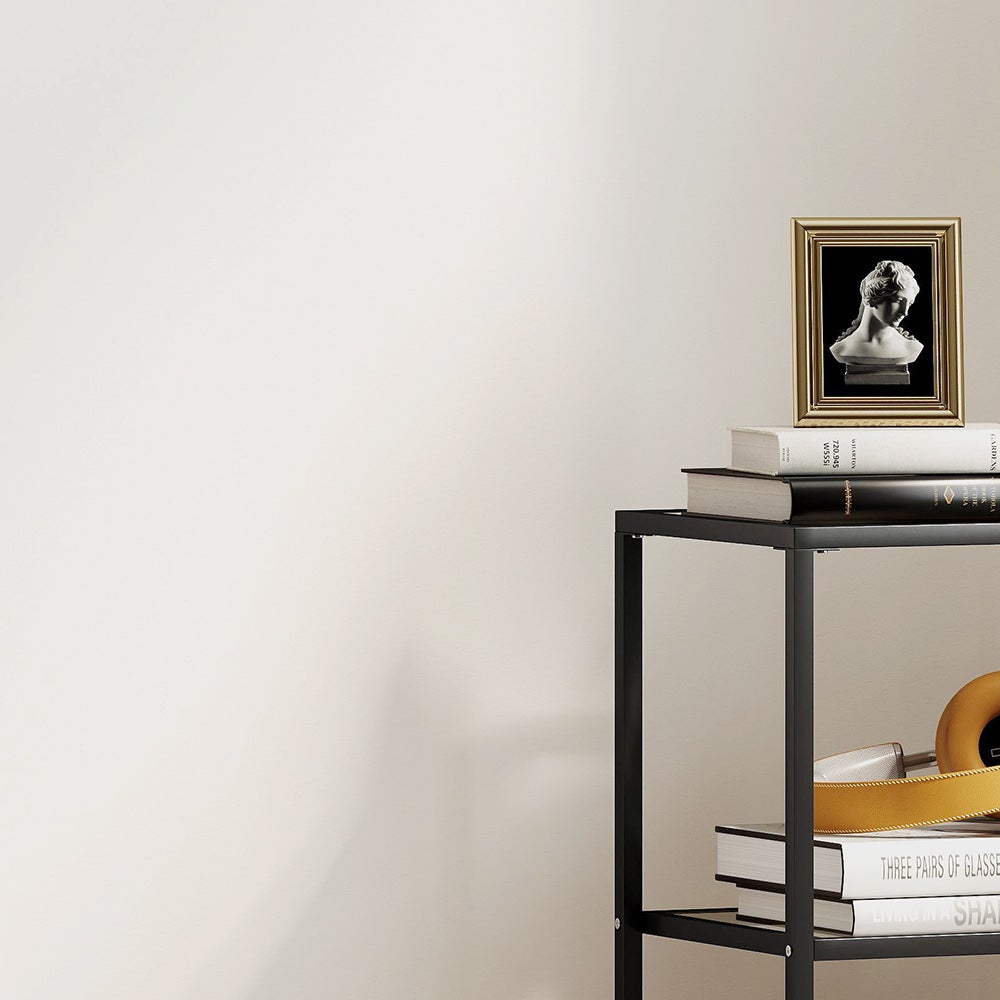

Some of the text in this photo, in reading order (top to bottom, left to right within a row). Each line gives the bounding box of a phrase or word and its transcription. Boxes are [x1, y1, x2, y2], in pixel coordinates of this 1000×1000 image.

[881, 856, 913, 880] THREE
[916, 854, 944, 879] PAIRS
[947, 854, 961, 878] OF
